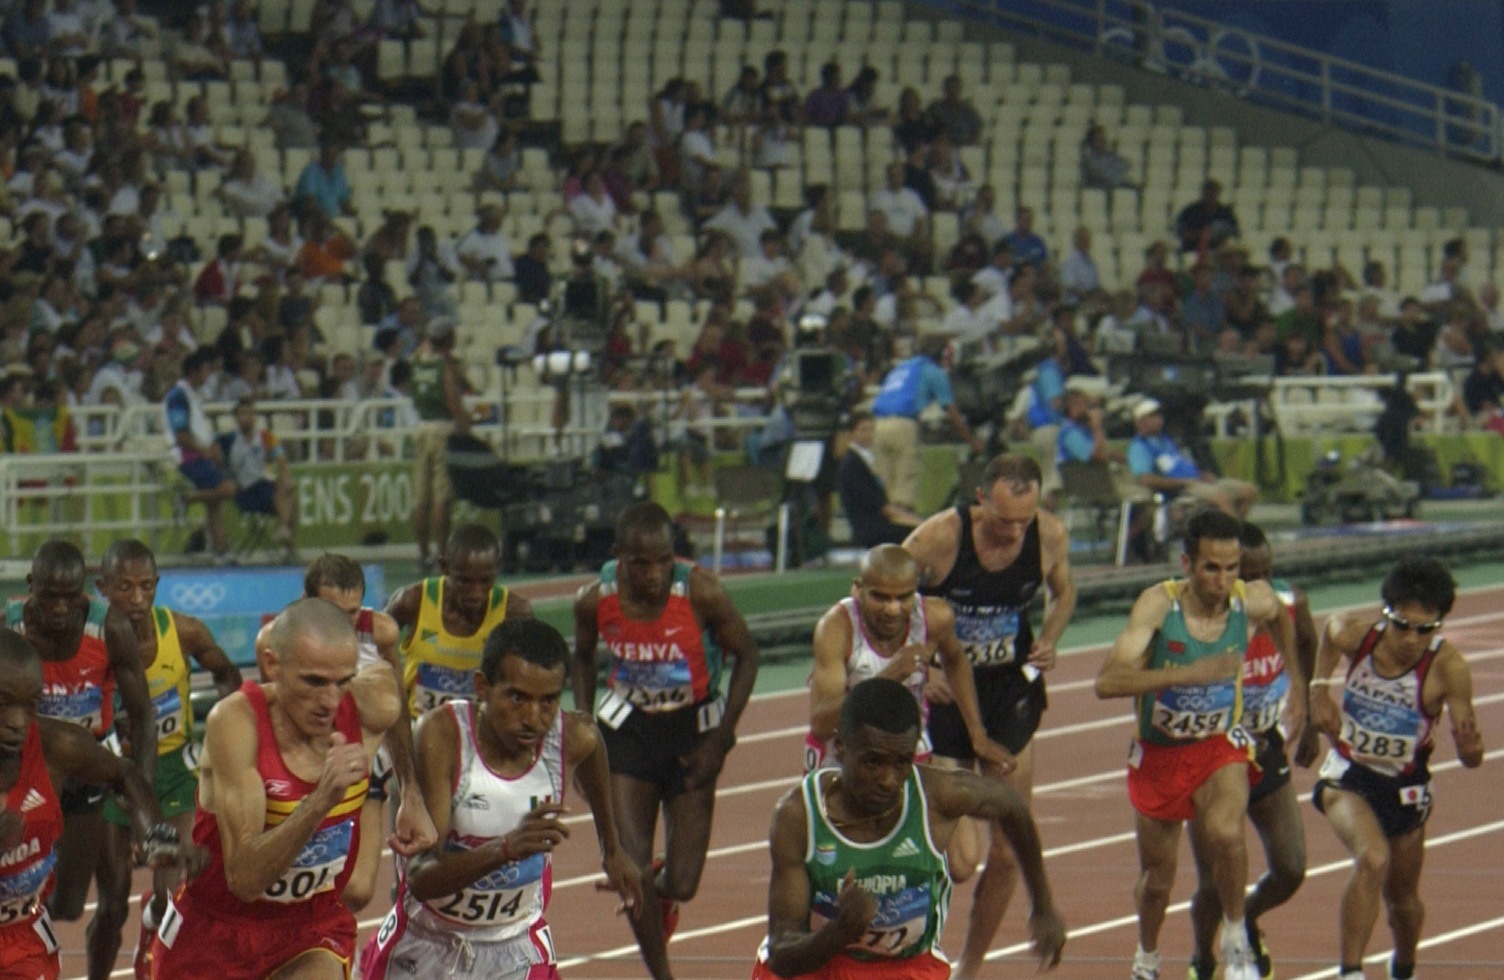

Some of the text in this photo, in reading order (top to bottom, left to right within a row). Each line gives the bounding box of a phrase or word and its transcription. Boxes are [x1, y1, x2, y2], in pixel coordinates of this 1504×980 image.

[299, 472, 412, 526] ENS 200
[610, 643, 685, 661] KENYA
[837, 874, 907, 894] EHIOPIA
[439, 889, 524, 921] 2514
